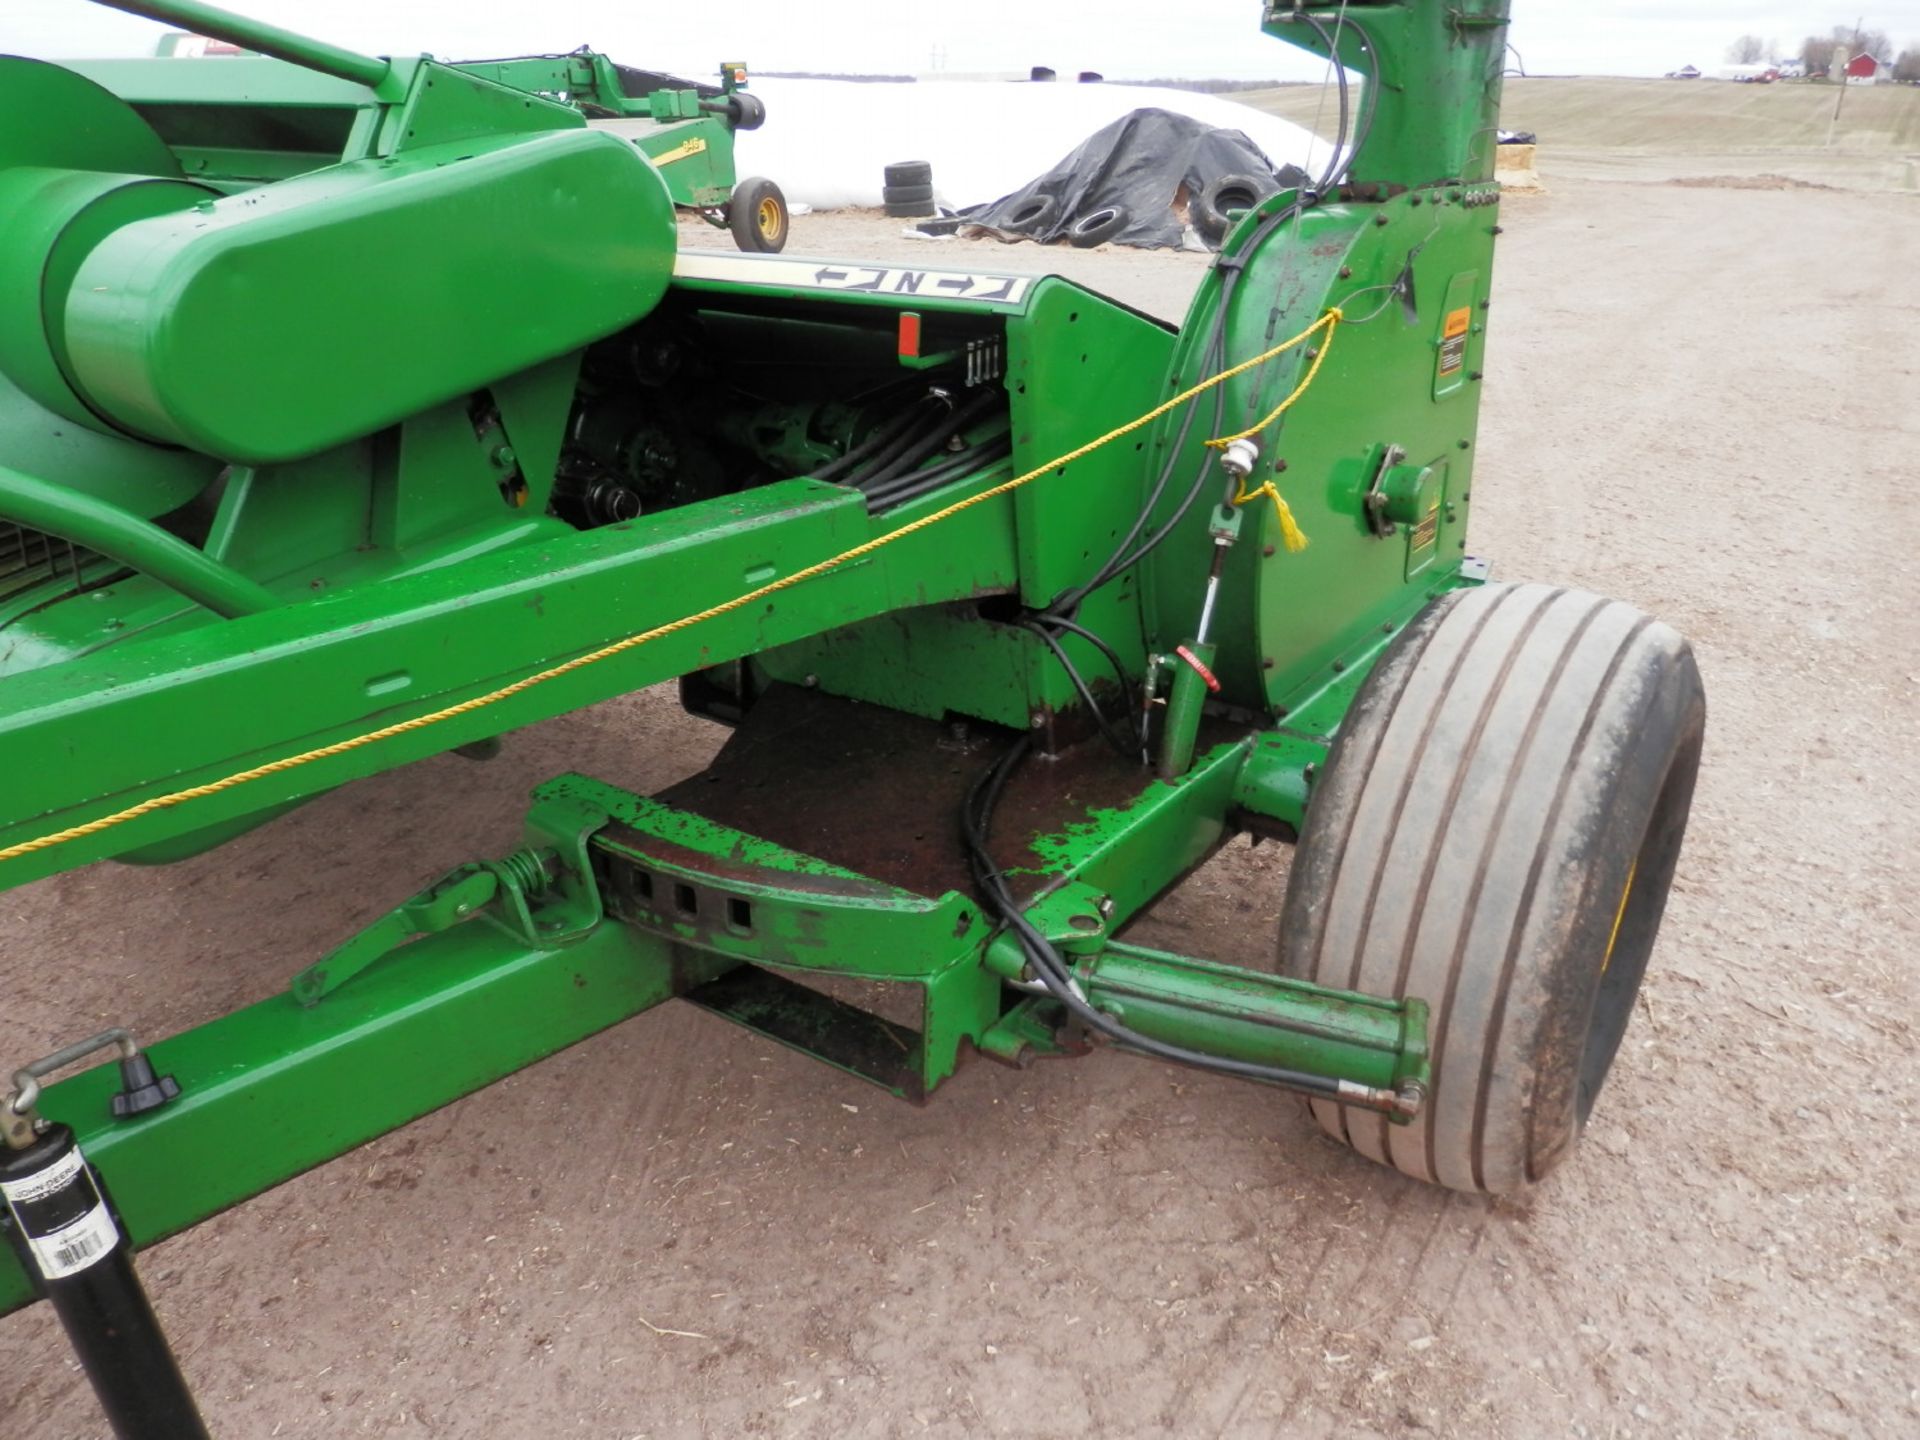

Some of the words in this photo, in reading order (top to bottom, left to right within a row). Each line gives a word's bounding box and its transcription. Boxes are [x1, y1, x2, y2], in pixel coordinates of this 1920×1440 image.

[894, 271, 926, 293] N
[15, 1184, 45, 1198] JOHN
[46, 1165, 77, 1187] DEERE
